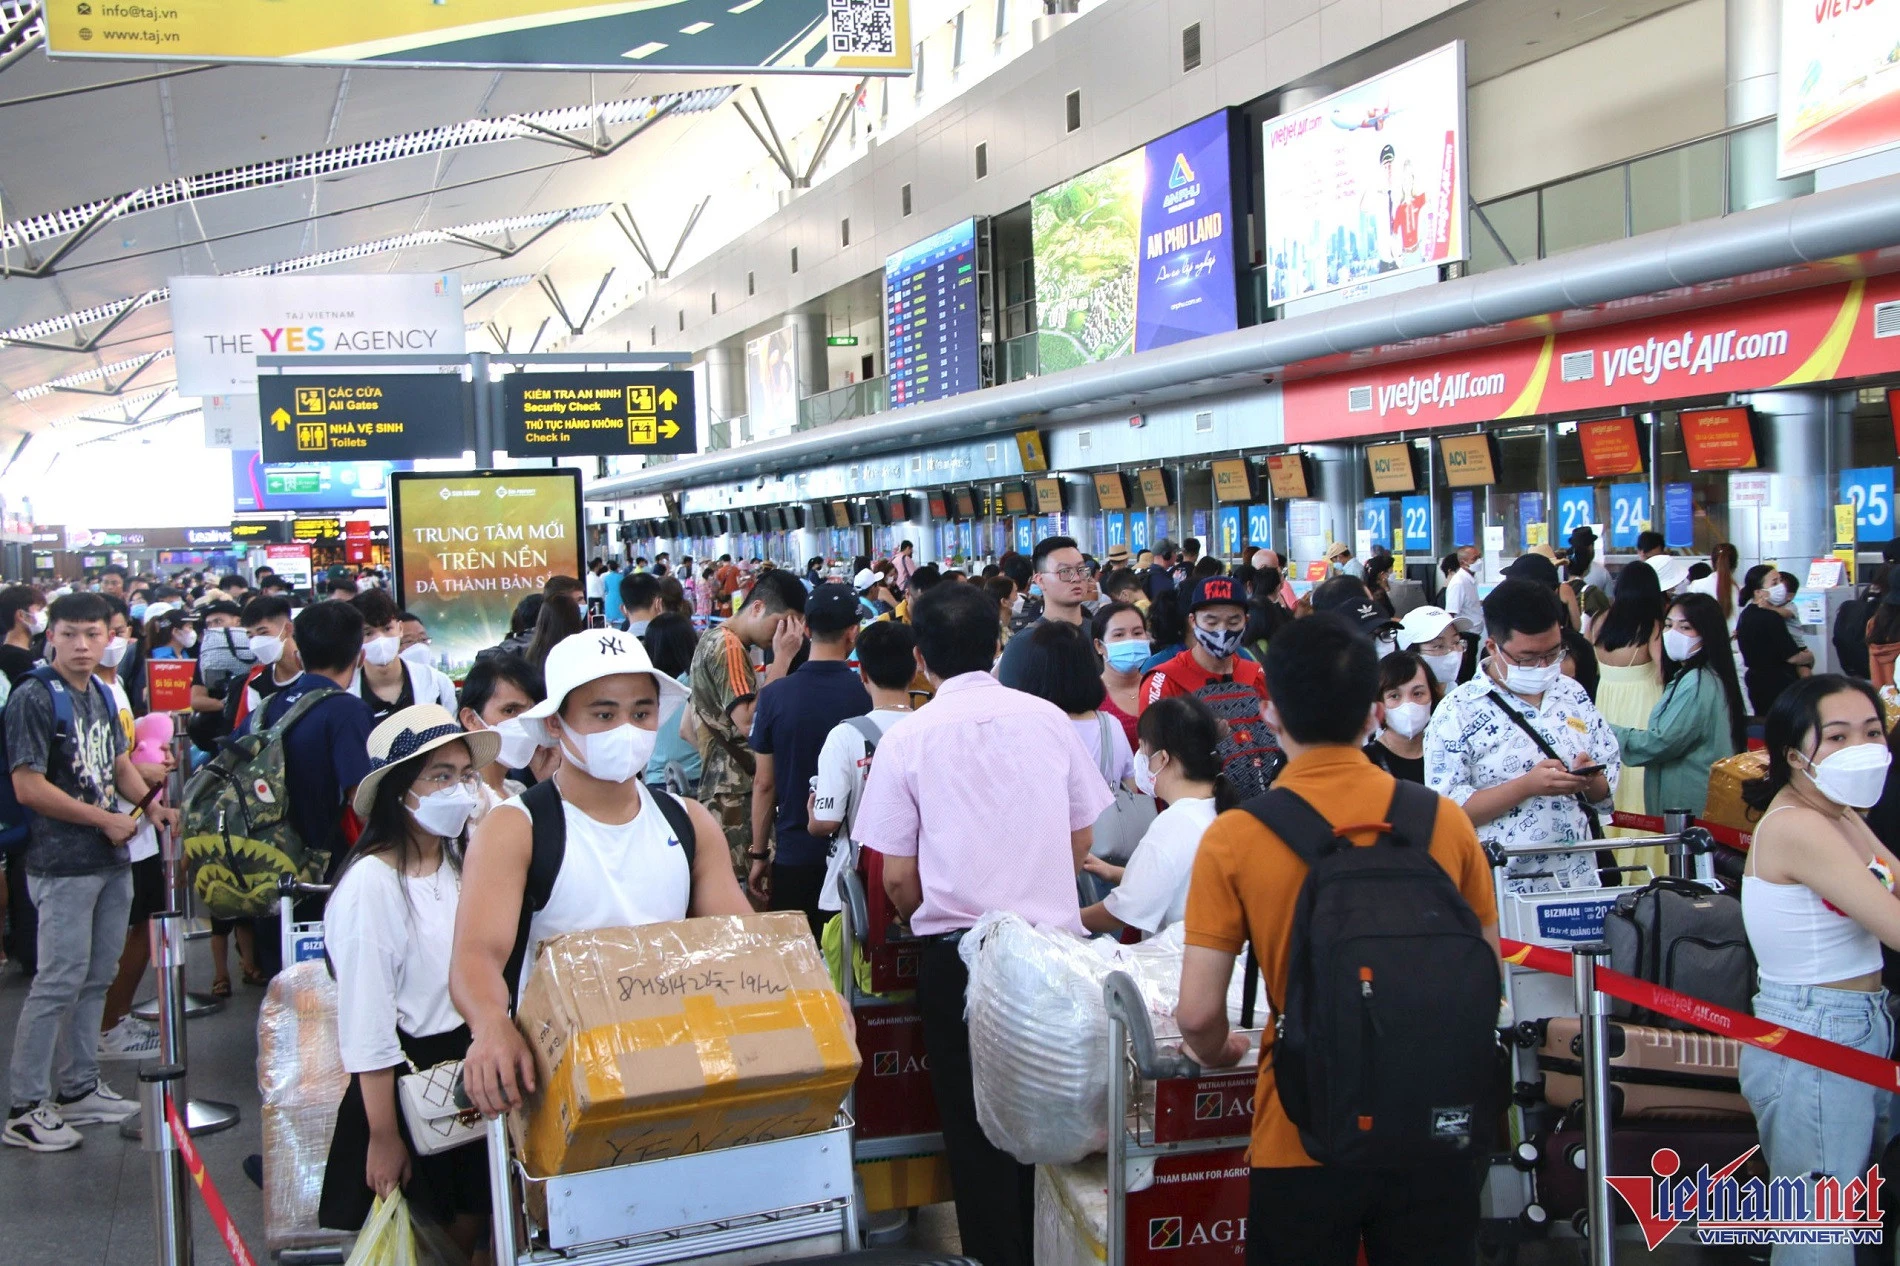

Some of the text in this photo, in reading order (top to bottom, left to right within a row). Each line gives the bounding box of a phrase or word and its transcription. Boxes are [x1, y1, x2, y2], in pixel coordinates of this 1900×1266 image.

[101, 5, 178, 21] info@taj.vn
[103, 30, 180, 44] www.taj.vn
[1164, 223, 1188, 254] PHU
[1189, 212, 1223, 246] LAND
[286, 310, 355, 320] TAJ VIETNAM
[204, 326, 437, 354] THE YES AGENCY
[328, 386, 354, 398] CÁC
[554, 389, 576, 400] TRA
[577, 389, 593, 400] AN
[595, 388, 622, 399] NINH
[328, 400, 379, 411] All Gates
[523, 402, 602, 414] Security Check
[330, 421, 404, 437] NHÀ VỆ SINH
[545, 420, 564, 432] TỤC
[564, 417, 591, 429] HÀNG
[591, 416, 624, 429] KHÔNG
[330, 437, 367, 448] Toilets
[525, 432, 571, 442] Check in
[1374, 457, 1391, 473] ACV
[1449, 451, 1467, 467] ACV
[1846, 483, 1888, 526] 25
[1406, 507, 1427, 538] 22
[1562, 499, 1590, 535] 23
[1614, 497, 1643, 534] 24
[1251, 515, 1268, 542] 20
[1367, 509, 1386, 539] 21
[413, 525, 479, 544] TRUNG
[484, 523, 524, 541] TÂM
[1018, 526, 1029, 548] 15
[1110, 522, 1122, 545] 17
[1132, 521, 1145, 546] 18
[437, 548, 496, 571] TRÊN
[442, 576, 497, 592] THÀNH
[598, 636, 626, 656] NY
[1543, 907, 1580, 918] BIZMAN
[1198, 1080, 1227, 1090] VIETNAM
[1227, 1079, 1244, 1088] BANK
[1155, 1175, 1180, 1185] TNAM
[1181, 1171, 1204, 1182] BANK
[1205, 1169, 1222, 1180] FOR
